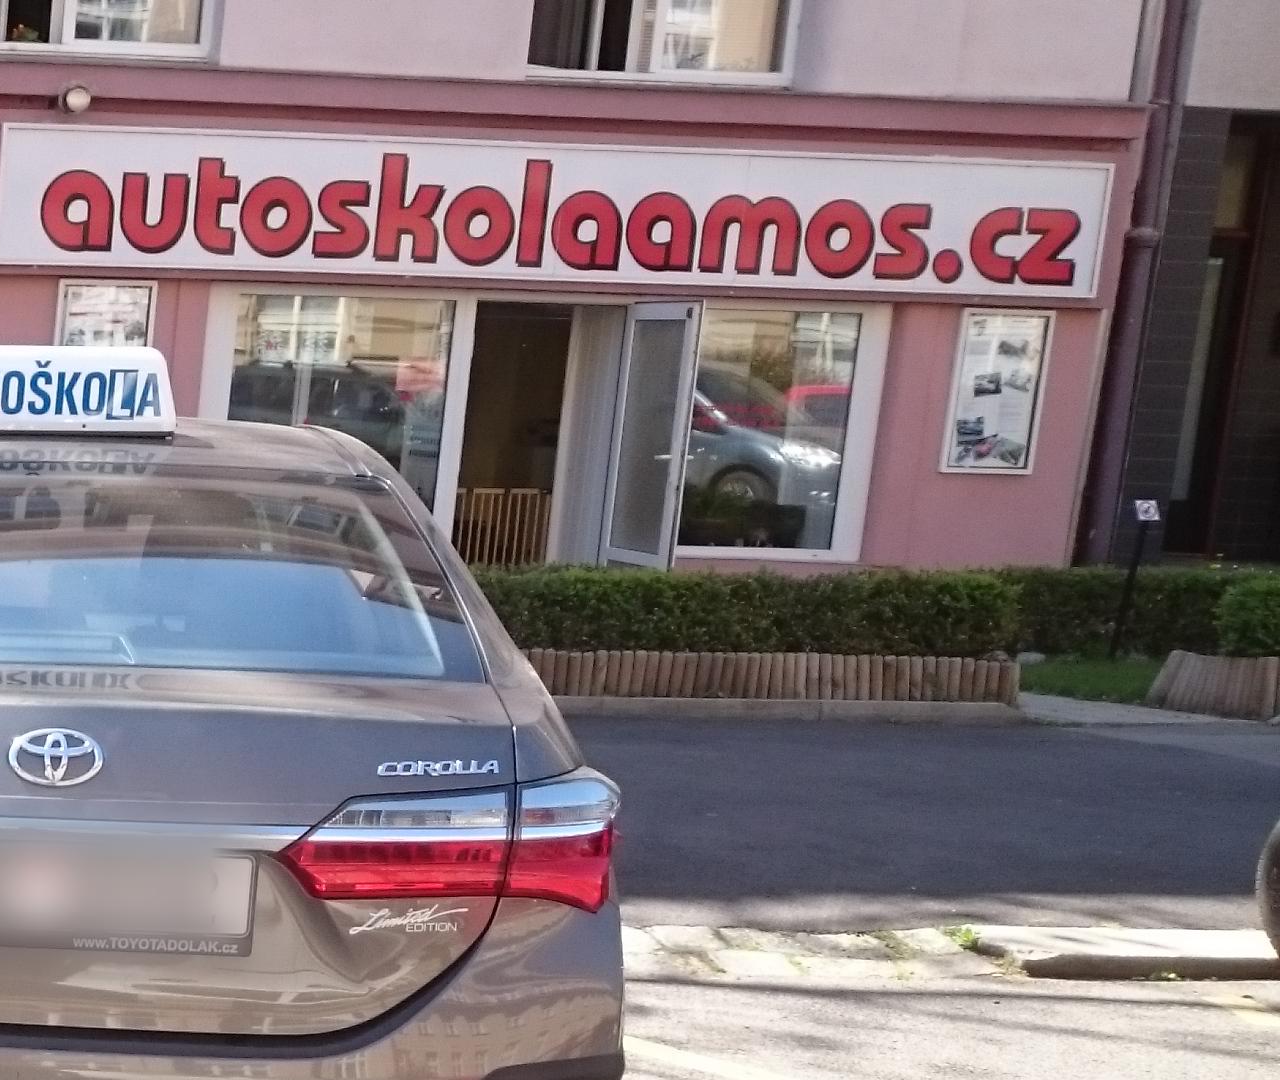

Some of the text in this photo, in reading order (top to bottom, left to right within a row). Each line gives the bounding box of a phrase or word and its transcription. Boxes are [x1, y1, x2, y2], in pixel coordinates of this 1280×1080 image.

[40, 152, 1081, 286] autoskolaamos.cz
[377, 759, 500, 777] COROLLA
[349, 904, 469, 935] Limited
[406, 922, 457, 932] EDITION
